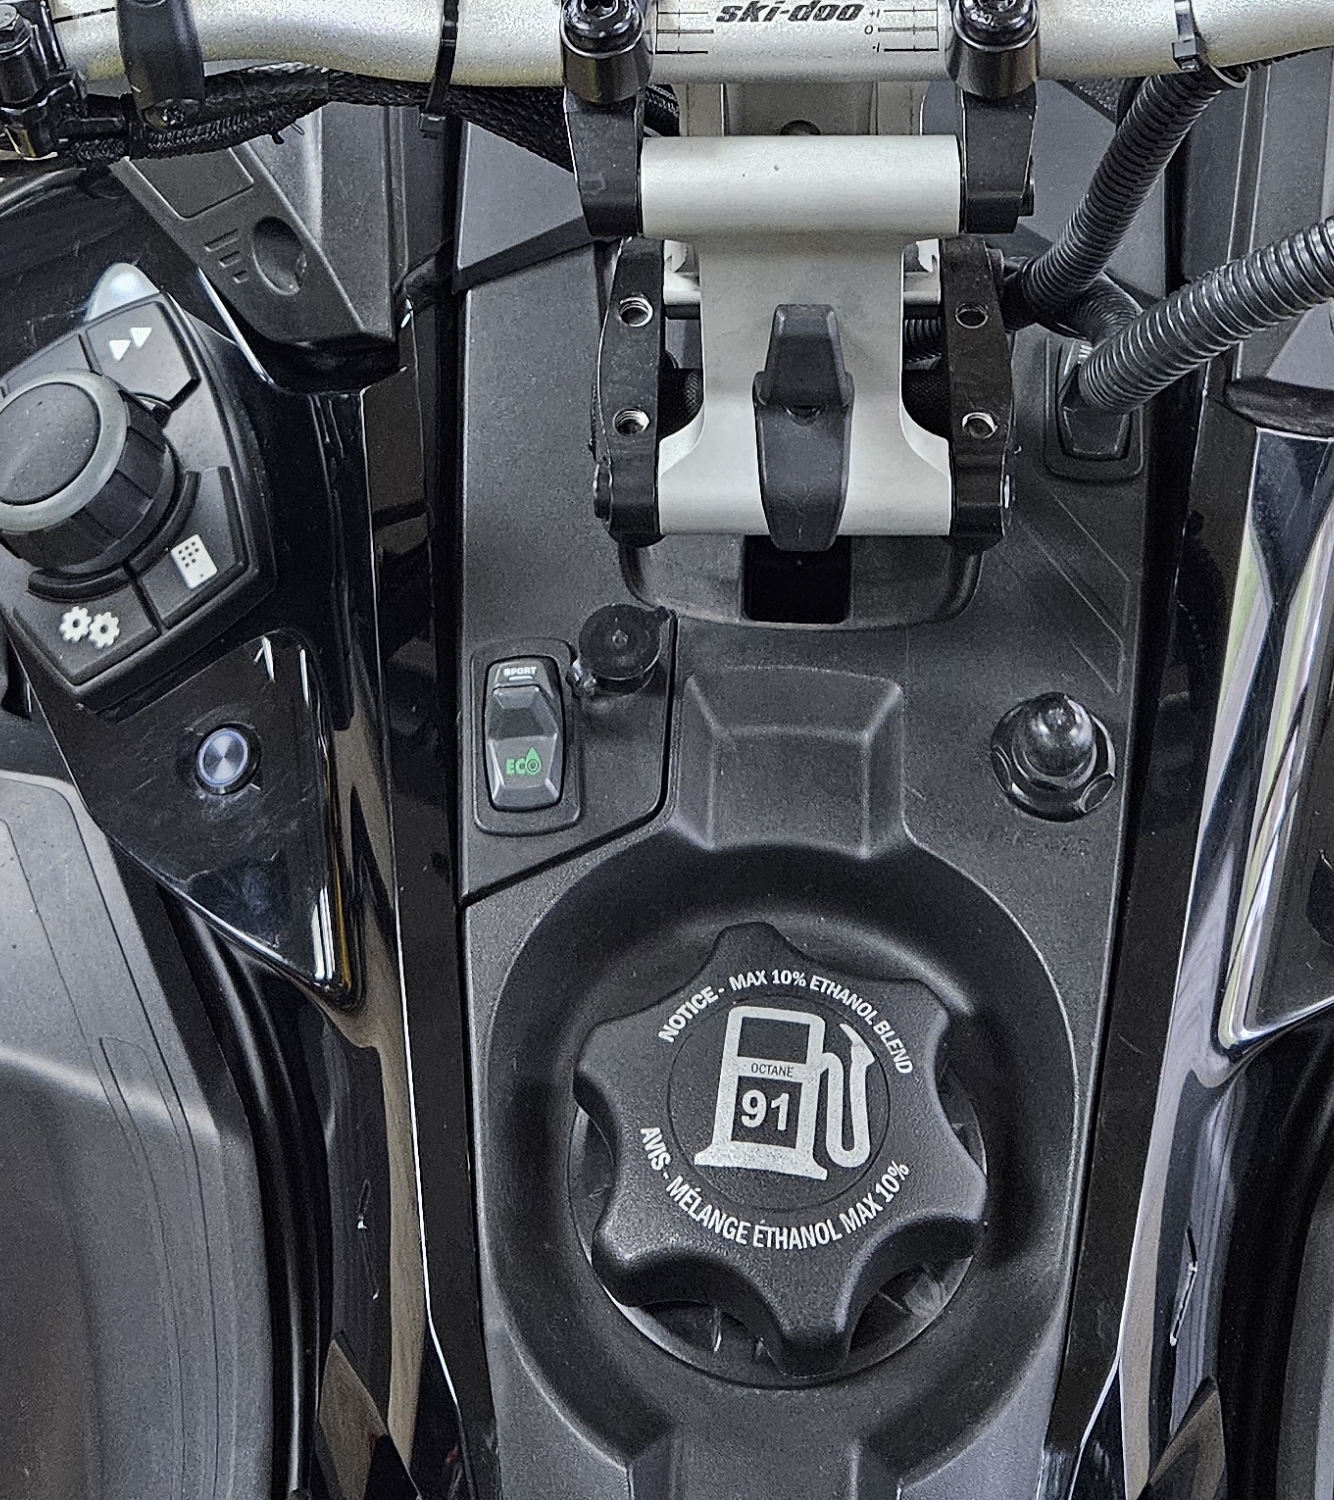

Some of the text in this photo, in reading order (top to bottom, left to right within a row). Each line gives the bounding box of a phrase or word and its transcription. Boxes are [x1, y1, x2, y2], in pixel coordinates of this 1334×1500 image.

[716, 0, 865, 24] ski-doo
[869, 8, 881, 19] +1
[503, 666, 537, 677] SPORT
[505, 746, 542, 776] ECO
[657, 985, 719, 1043] NOTICE
[728, 969, 768, 991] MAX
[771, 969, 807, 987] 10%
[809, 975, 878, 1026] ETHANOL
[873, 1020, 914, 1076] BLEND
[750, 1062, 795, 1078] OCTANE
[741, 1089, 791, 1132] 91
[640, 1126, 671, 1173] AVIS
[665, 1175, 754, 1246] MÉLANGE
[753, 1220, 843, 1250] ÉTHANOL
[839, 1193, 884, 1234] MAX
[874, 1160, 910, 1204] 10%
